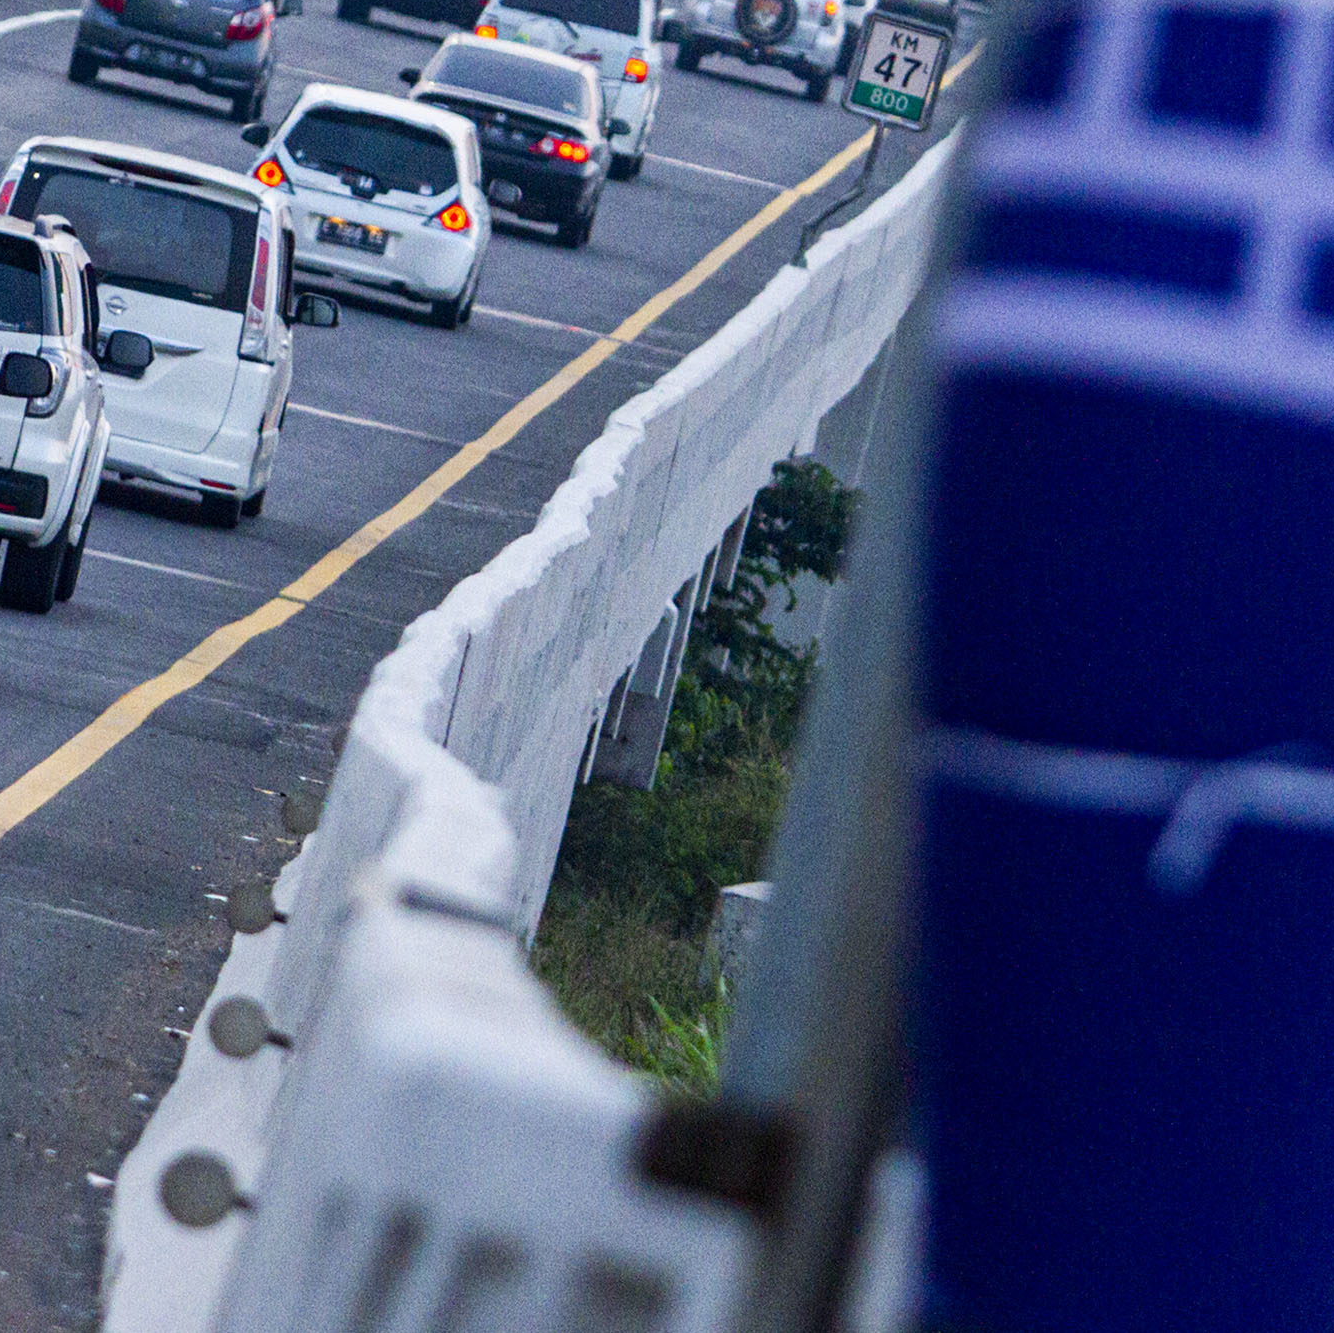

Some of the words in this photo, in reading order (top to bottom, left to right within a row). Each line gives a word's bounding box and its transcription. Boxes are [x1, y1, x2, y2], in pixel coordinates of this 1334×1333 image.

[890, 30, 919, 53] KM
[874, 51, 923, 88] 47
[870, 88, 909, 112] 800
